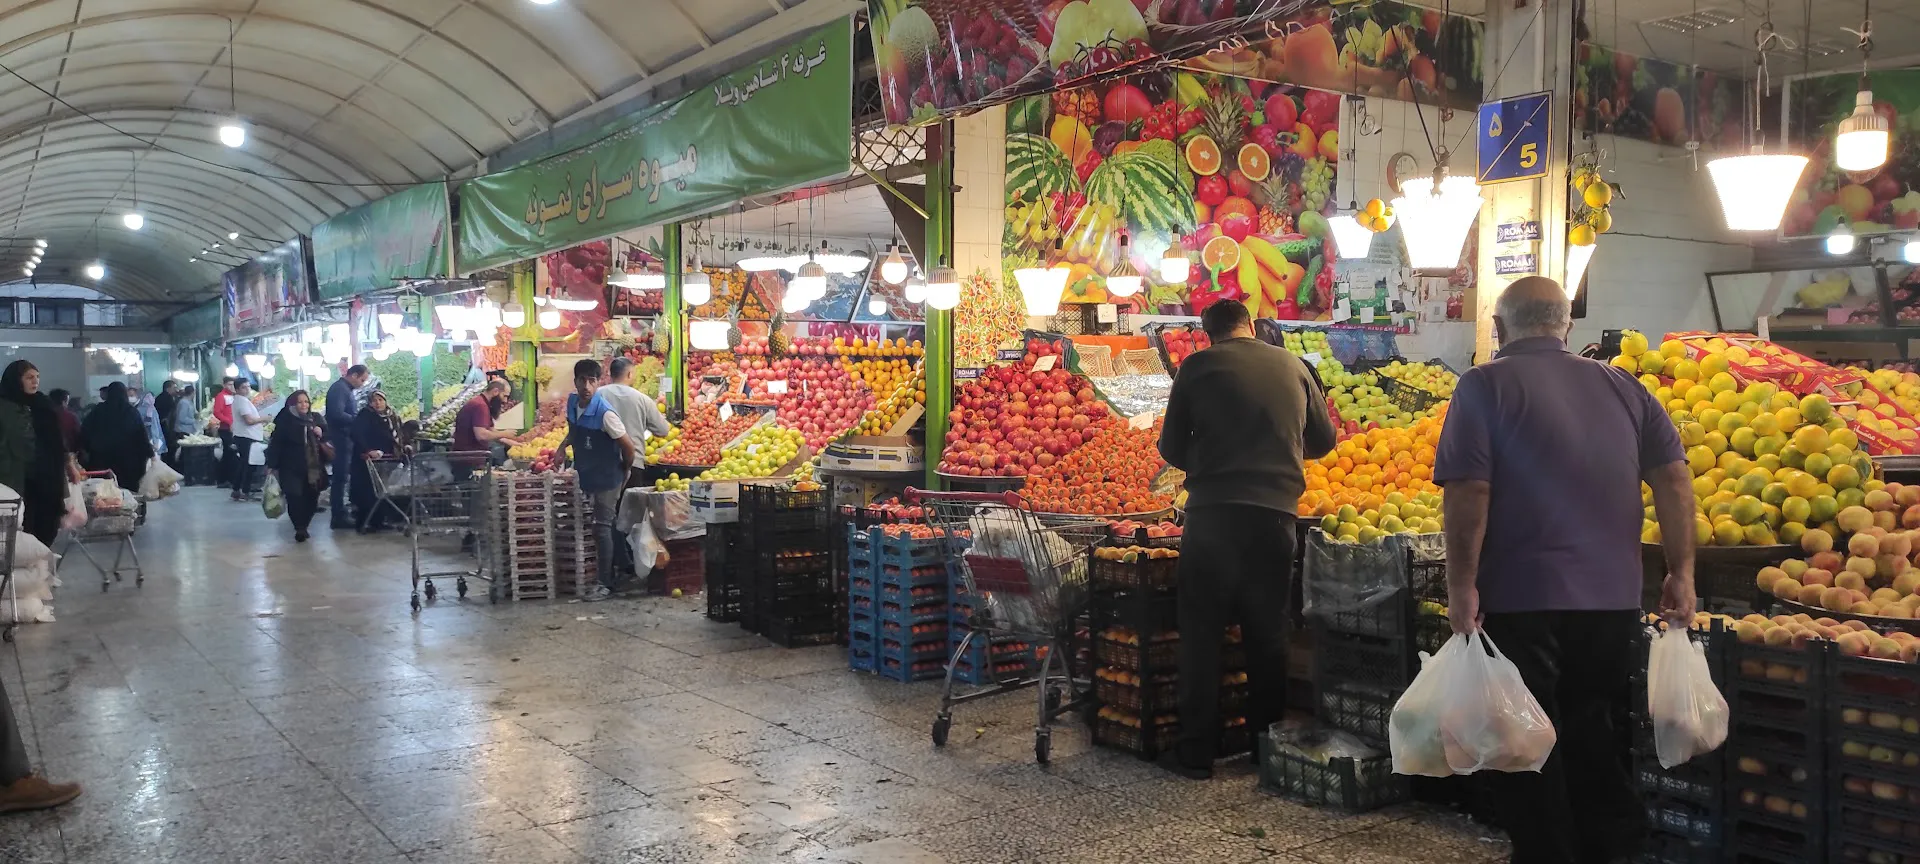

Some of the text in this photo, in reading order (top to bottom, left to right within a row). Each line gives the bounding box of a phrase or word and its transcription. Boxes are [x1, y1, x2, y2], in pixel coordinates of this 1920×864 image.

[792, 40, 827, 78] غرفه
[714, 84, 741, 106] ویلا
[741, 61, 779, 102] شاهین
[638, 143, 698, 204] میوه
[1520, 143, 1538, 168] 5
[525, 171, 573, 237] نمونه
[576, 159, 634, 225] سرای
[1503, 225, 1538, 236] ROMAK
[1500, 257, 1535, 268] ROMAK
